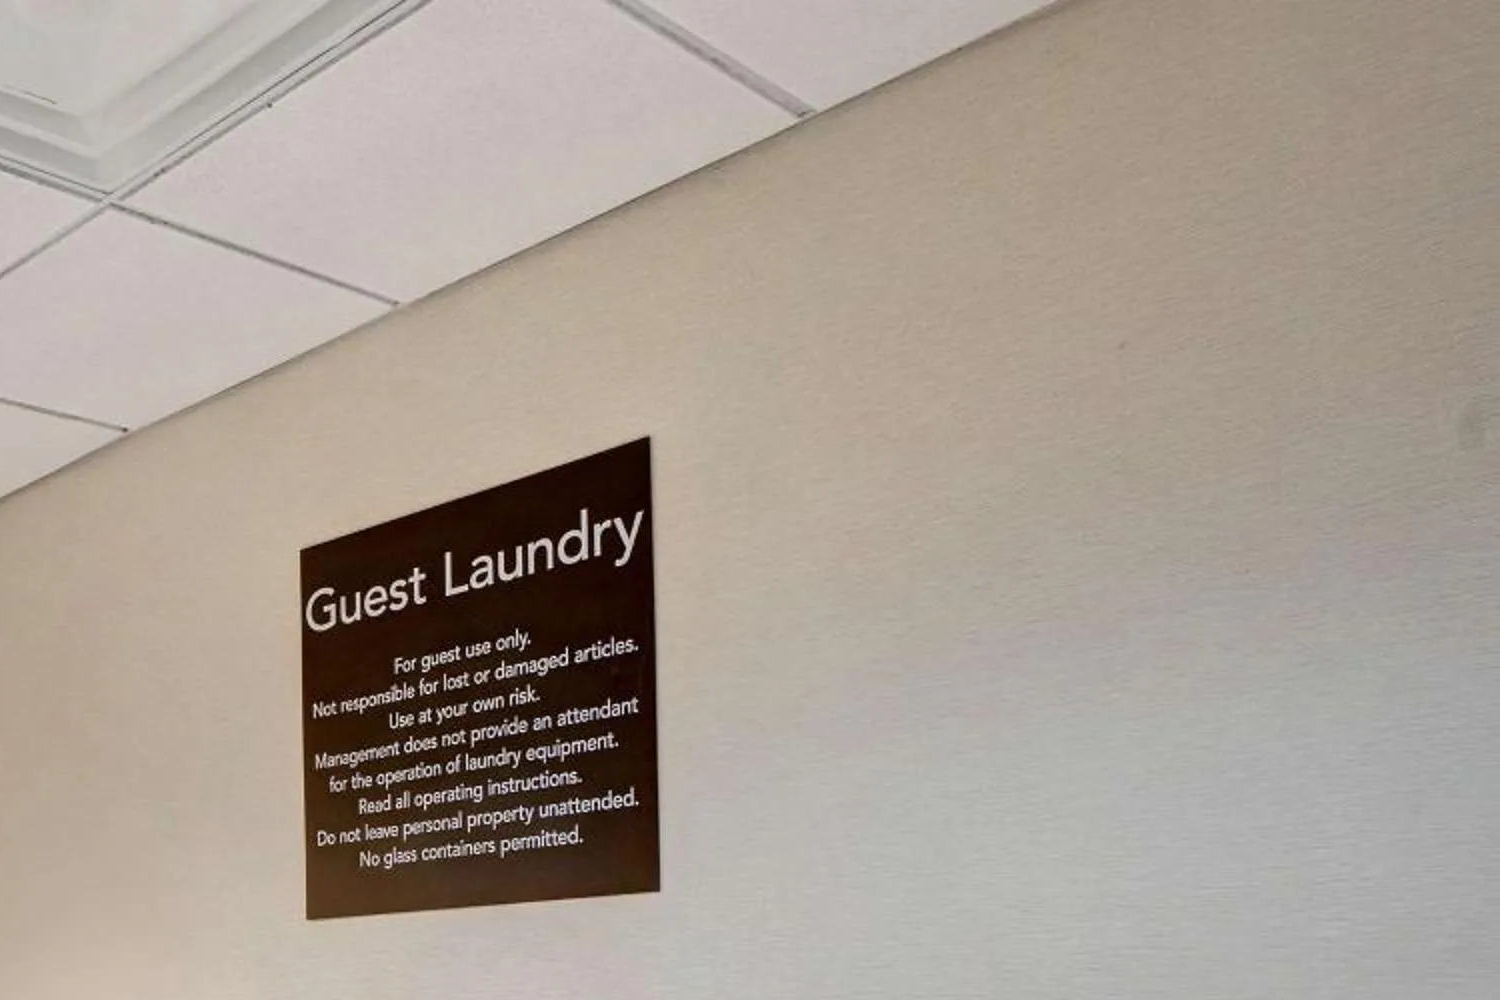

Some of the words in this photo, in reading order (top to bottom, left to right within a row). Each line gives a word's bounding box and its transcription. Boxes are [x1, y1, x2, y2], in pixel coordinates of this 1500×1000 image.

[306, 568, 426, 632] Guest
[445, 508, 644, 598] Laundry
[313, 702, 336, 718] Not
[341, 684, 414, 715] responsible
[419, 679, 437, 696] for
[443, 672, 469, 691] lost
[474, 669, 490, 683] or
[495, 649, 568, 680] damaged
[574, 636, 638, 661] articles.
[394, 657, 415, 674] For
[422, 646, 460, 671] guest
[465, 641, 490, 655] use
[496, 629, 531, 651] only.
[315, 742, 400, 770] Management
[404, 734, 437, 752] does
[442, 728, 466, 745] not
[471, 715, 528, 748] provide
[533, 714, 551, 731] an
[557, 697, 638, 728] attendant
[389, 712, 413, 729] Use
[418, 708, 432, 723] at
[436, 702, 468, 724] your
[473, 695, 504, 713] own
[510, 684, 540, 705] risk.
[330, 775, 346, 792] for
[351, 772, 372, 790] the
[376, 764, 441, 788] operation
[446, 755, 460, 774] of
[465, 746, 521, 772] laundry
[526, 731, 619, 763] equipment.
[317, 830, 336, 846] Do
[340, 826, 360, 842] not
[365, 822, 398, 840] leave
[403, 809, 462, 841] personal
[467, 804, 533, 830] property
[539, 787, 638, 818] unattended.
[359, 798, 390, 814] Read
[396, 792, 410, 809] all
[414, 784, 482, 809] operating
[488, 769, 582, 796] instructions.
[360, 852, 379, 868] No
[384, 841, 417, 869] glass
[422, 832, 495, 860] containers
[500, 826, 583, 858] permitted.
